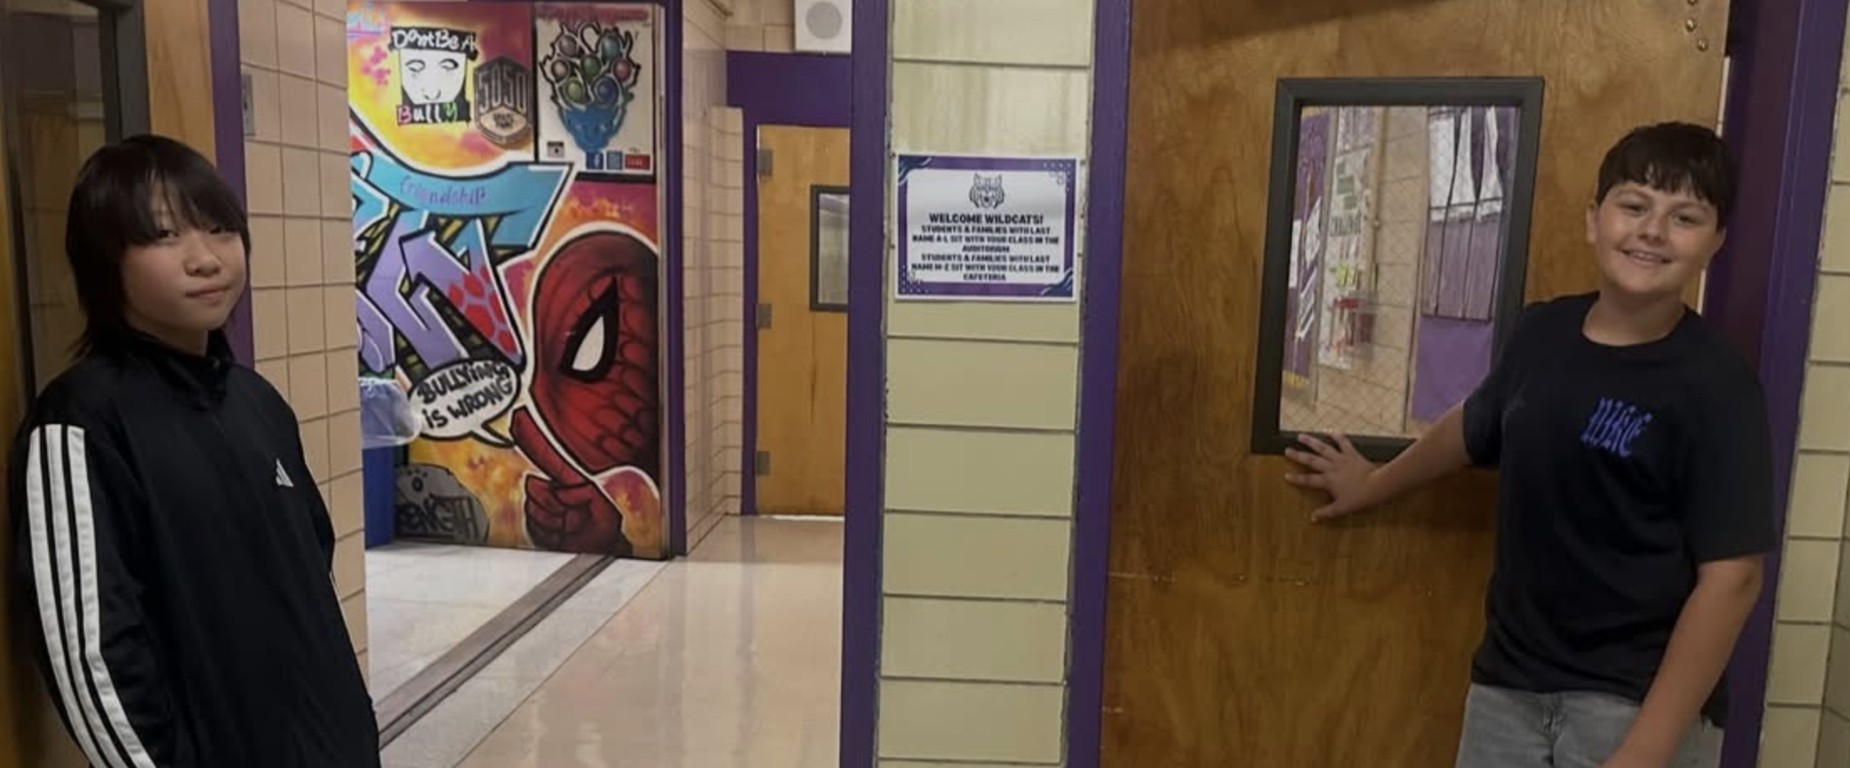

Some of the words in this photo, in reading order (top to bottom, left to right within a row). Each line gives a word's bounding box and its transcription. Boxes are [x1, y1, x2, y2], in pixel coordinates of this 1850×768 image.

[435, 29, 459, 50] Be
[929, 213, 982, 224] WELCOME
[984, 214, 1043, 225] WILDCATS!
[921, 225, 962, 233] STUDENTS
[964, 225, 970, 233] &
[971, 225, 1007, 234] FAMILIES
[1009, 226, 1029, 234] WITH
[1030, 227, 1050, 235] LAST
[950, 235, 962, 243] SIT
[964, 235, 985, 243] WITH
[1008, 236, 1033, 244] CLASS
[1035, 236, 1043, 244] IN
[1044, 236, 1059, 244] THE
[962, 245, 1010, 253] AUDITORIUM
[921, 253, 962, 261] STUDENTS
[964, 254, 970, 262] &
[971, 254, 1007, 262] FAMILIES
[1009, 255, 1029, 263] WITH
[1030, 255, 1050, 263] LAST
[911, 263, 933, 271] NAME
[951, 263, 963, 271] SIT
[965, 264, 986, 272] WITH
[987, 264, 1007, 272] YOUR
[1008, 265, 1034, 273] CLASS
[1035, 265, 1043, 273] IN
[1045, 265, 1059, 273] THE
[963, 273, 1006, 281] CAFETERIA
[447, 379, 513, 419] WRONG
